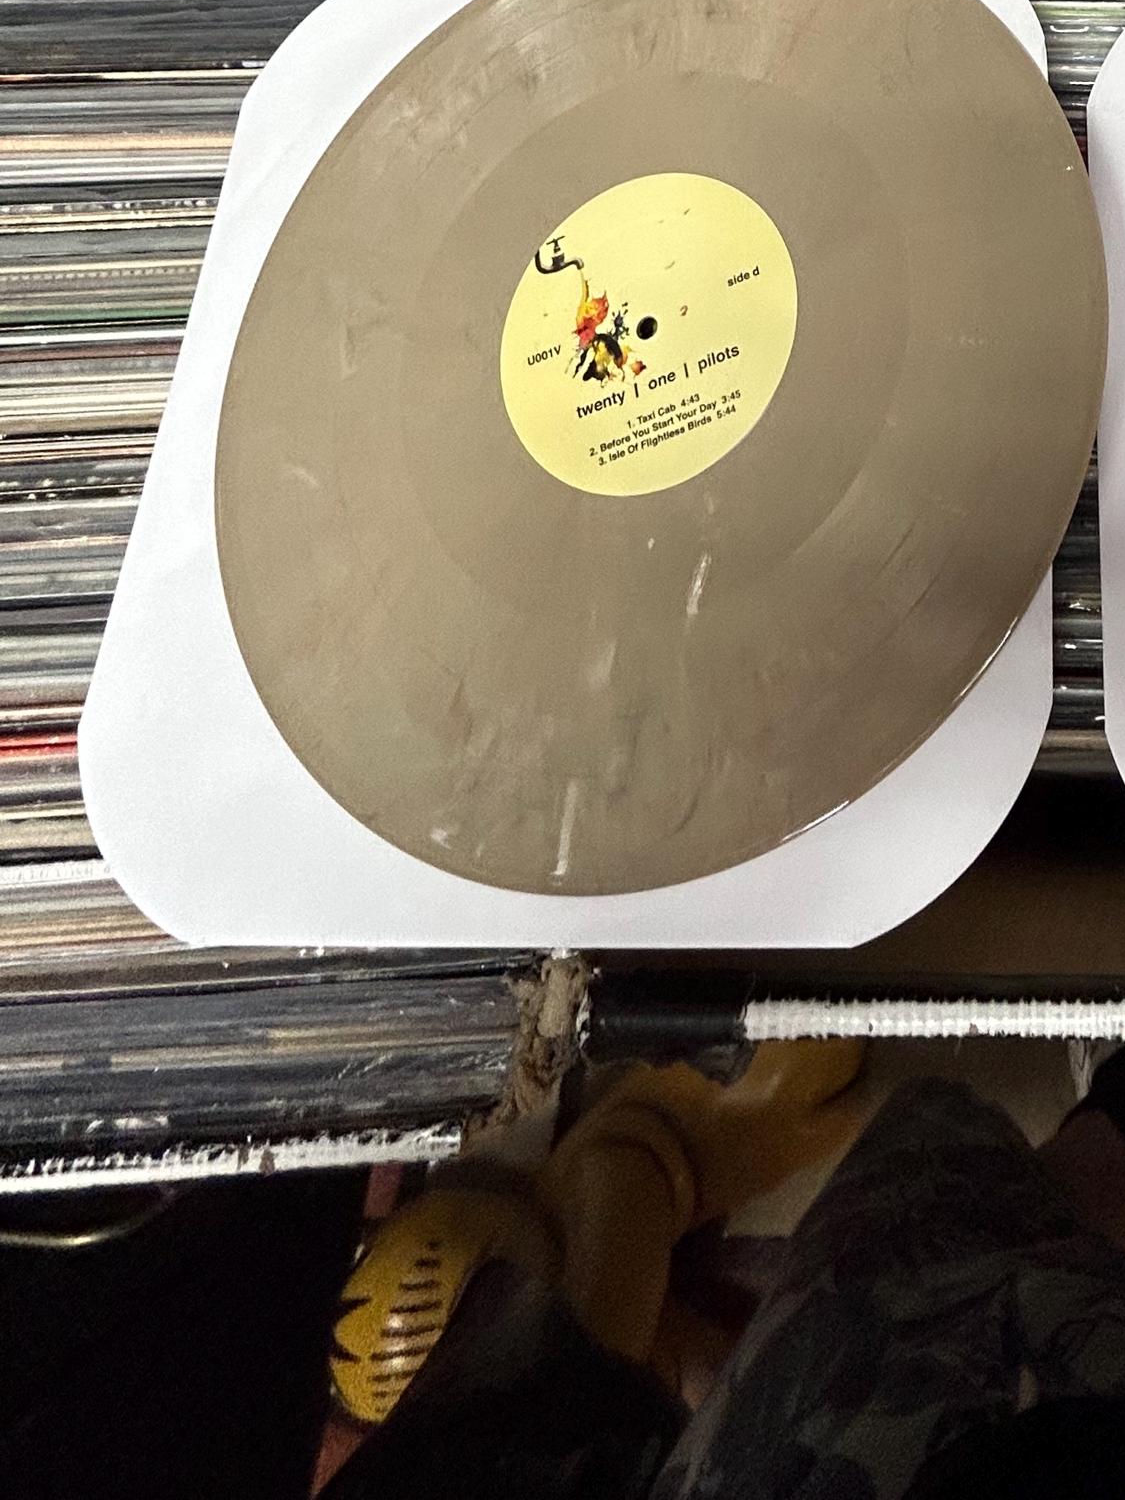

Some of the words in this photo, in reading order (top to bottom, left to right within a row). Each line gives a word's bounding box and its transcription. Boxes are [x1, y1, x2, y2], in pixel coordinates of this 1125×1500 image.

[727, 271, 752, 288] side
[752, 266, 760, 278] d
[527, 345, 562, 367] U001V
[576, 389, 626, 419] twenty
[648, 371, 677, 392] one
[697, 344, 741, 373] pilots
[589, 446, 599, 457] 2.
[599, 434, 631, 453] Before
[631, 425, 651, 443] You
[651, 416, 674, 434] Start
[674, 407, 699, 425] Your
[699, 399, 718, 418] Day
[721, 389, 742, 404] 3:45
[597, 455, 608, 467] 3.
[608, 447, 626, 464] Isle
[626, 443, 640, 457] Of
[640, 423, 686, 451] Flightless
[687, 414, 713, 432] Birds
[716, 404, 737, 420] 5:44
[627, 419, 636, 430] 1.
[636, 409, 657, 427] Taxi
[657, 402, 677, 418] Cab
[680, 393, 701, 409] 4:43
